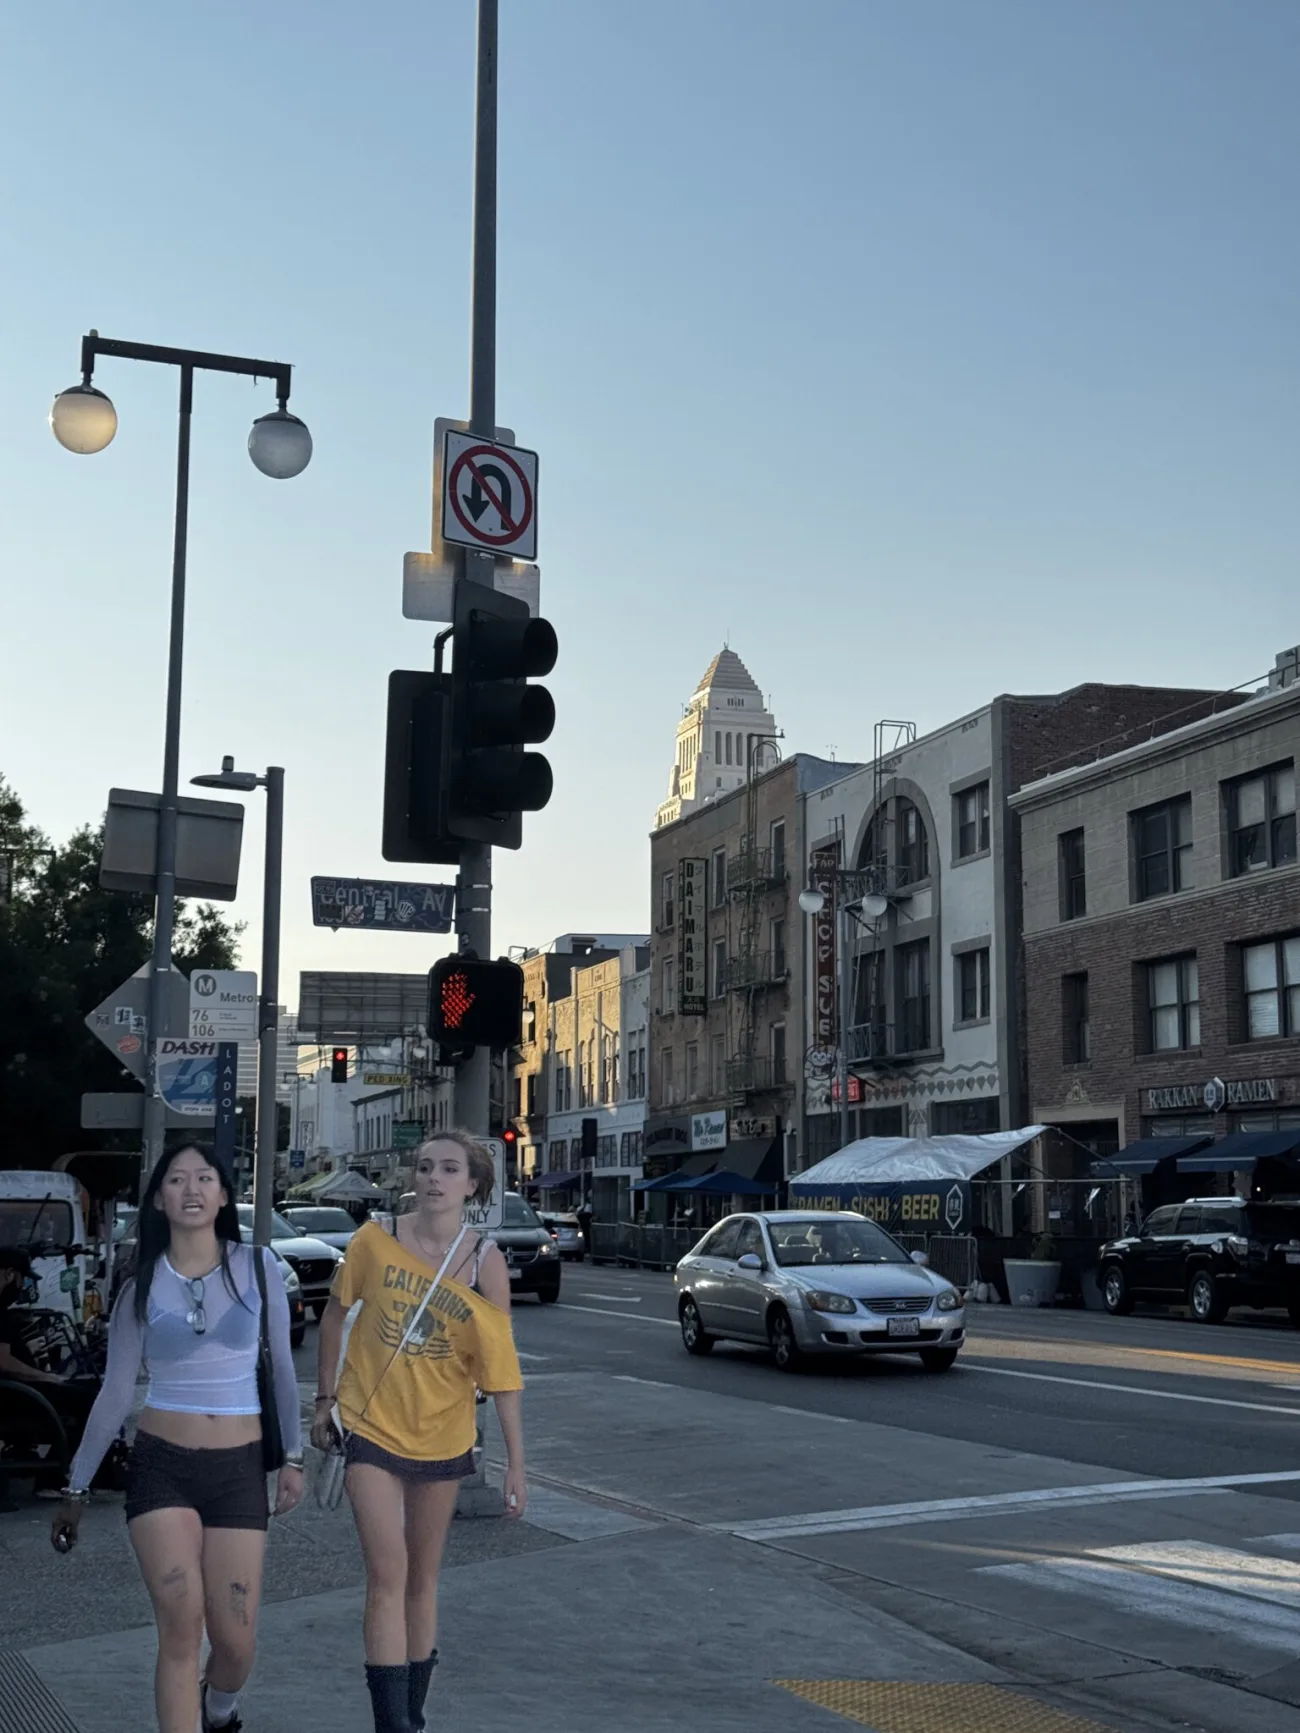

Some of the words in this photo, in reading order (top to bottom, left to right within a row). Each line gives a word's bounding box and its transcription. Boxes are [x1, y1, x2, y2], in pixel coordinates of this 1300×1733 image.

[685, 862, 695, 993] DAIMARU
[219, 992, 254, 1003] Metro
[684, 1003, 705, 1011] HOTEL
[818, 973, 833, 1048] SUE
[192, 1010, 209, 1022] 76
[192, 1025, 215, 1037] 106
[161, 1041, 217, 1056] DASH
[222, 1049, 232, 1124] LADOT
[367, 1075, 385, 1083] PED
[388, 1075, 408, 1084] XING
[1148, 1086, 1199, 1109] RAKKAN
[1227, 1079, 1277, 1103] RAMEN
[851, 1196, 889, 1220] SUSHI
[901, 1194, 939, 1220] BEER
